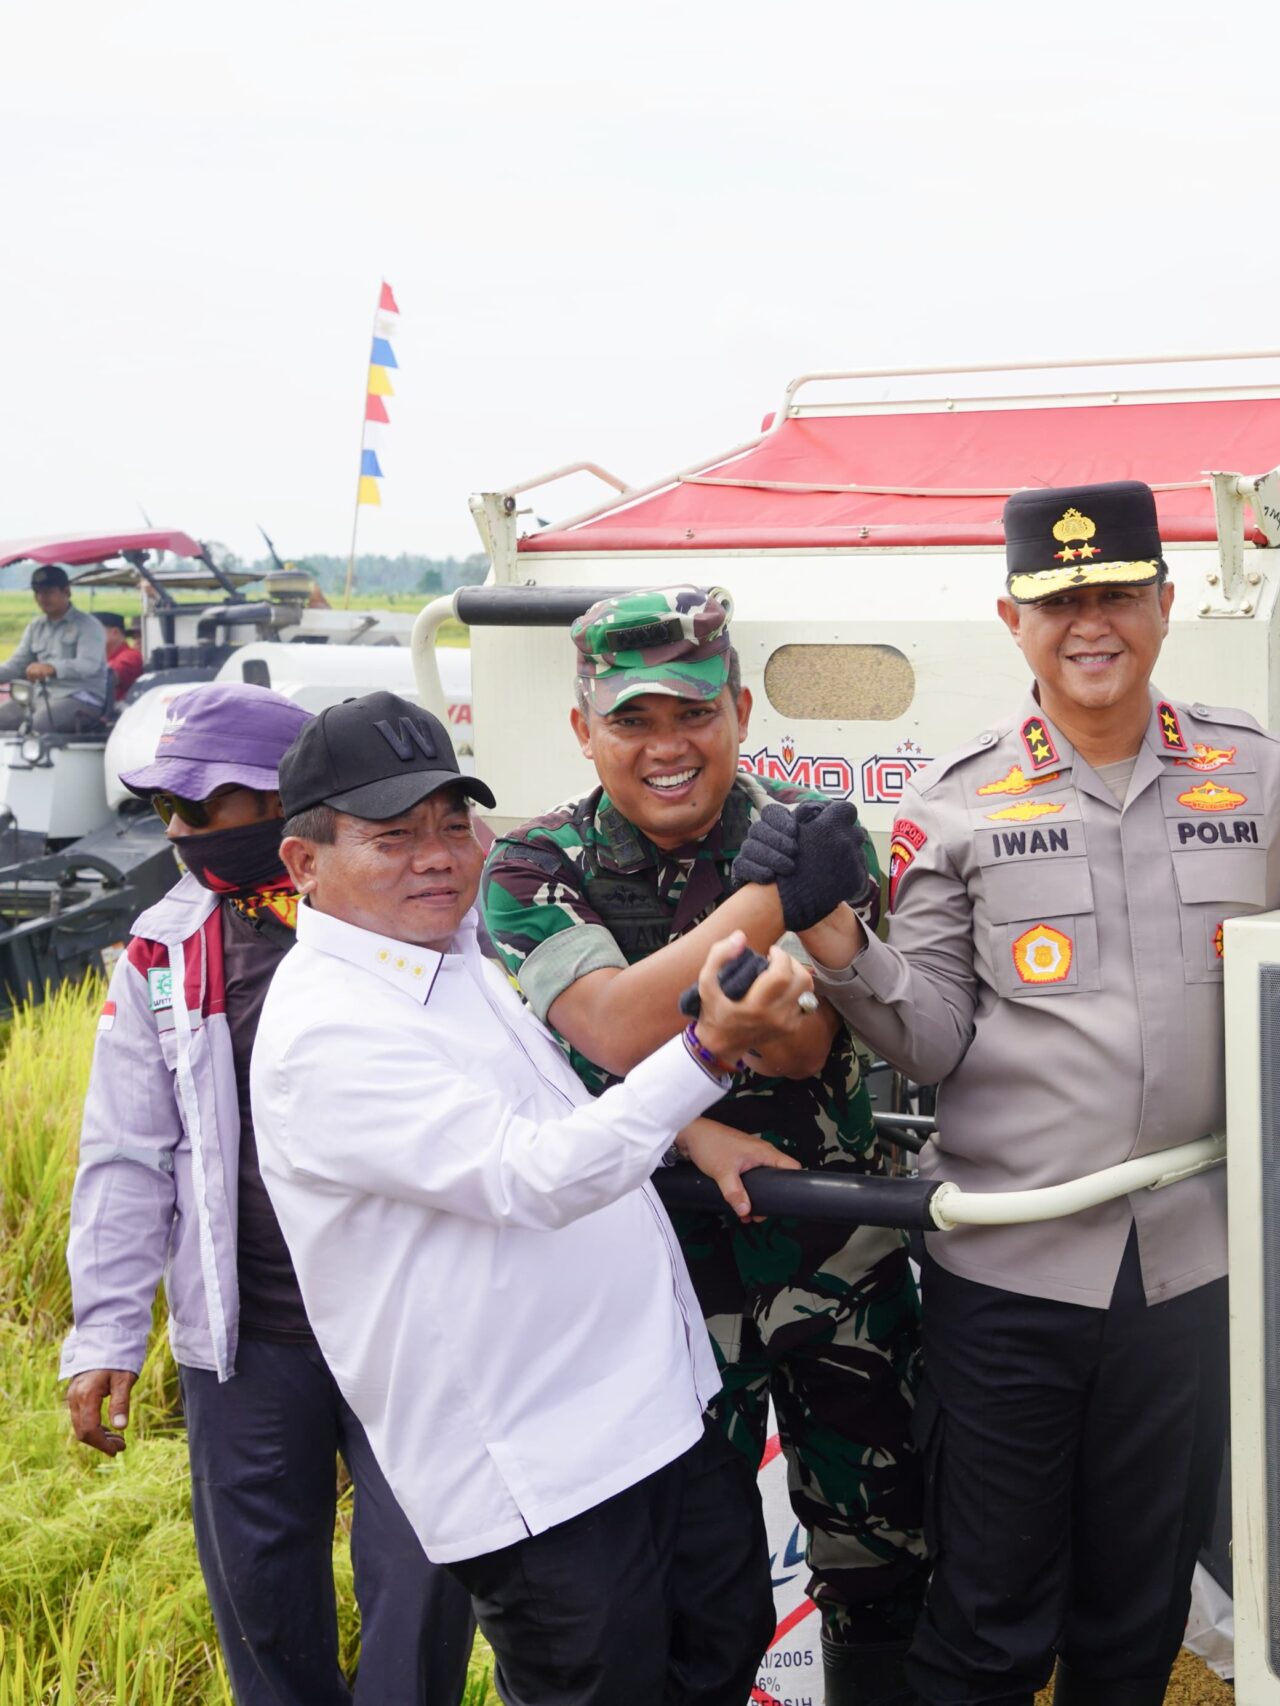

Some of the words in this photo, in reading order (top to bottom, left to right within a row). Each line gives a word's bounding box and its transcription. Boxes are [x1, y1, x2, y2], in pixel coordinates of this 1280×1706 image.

[372, 716, 438, 761] W
[992, 827, 1069, 858] IWAN
[1178, 820, 1259, 844] POLRI
